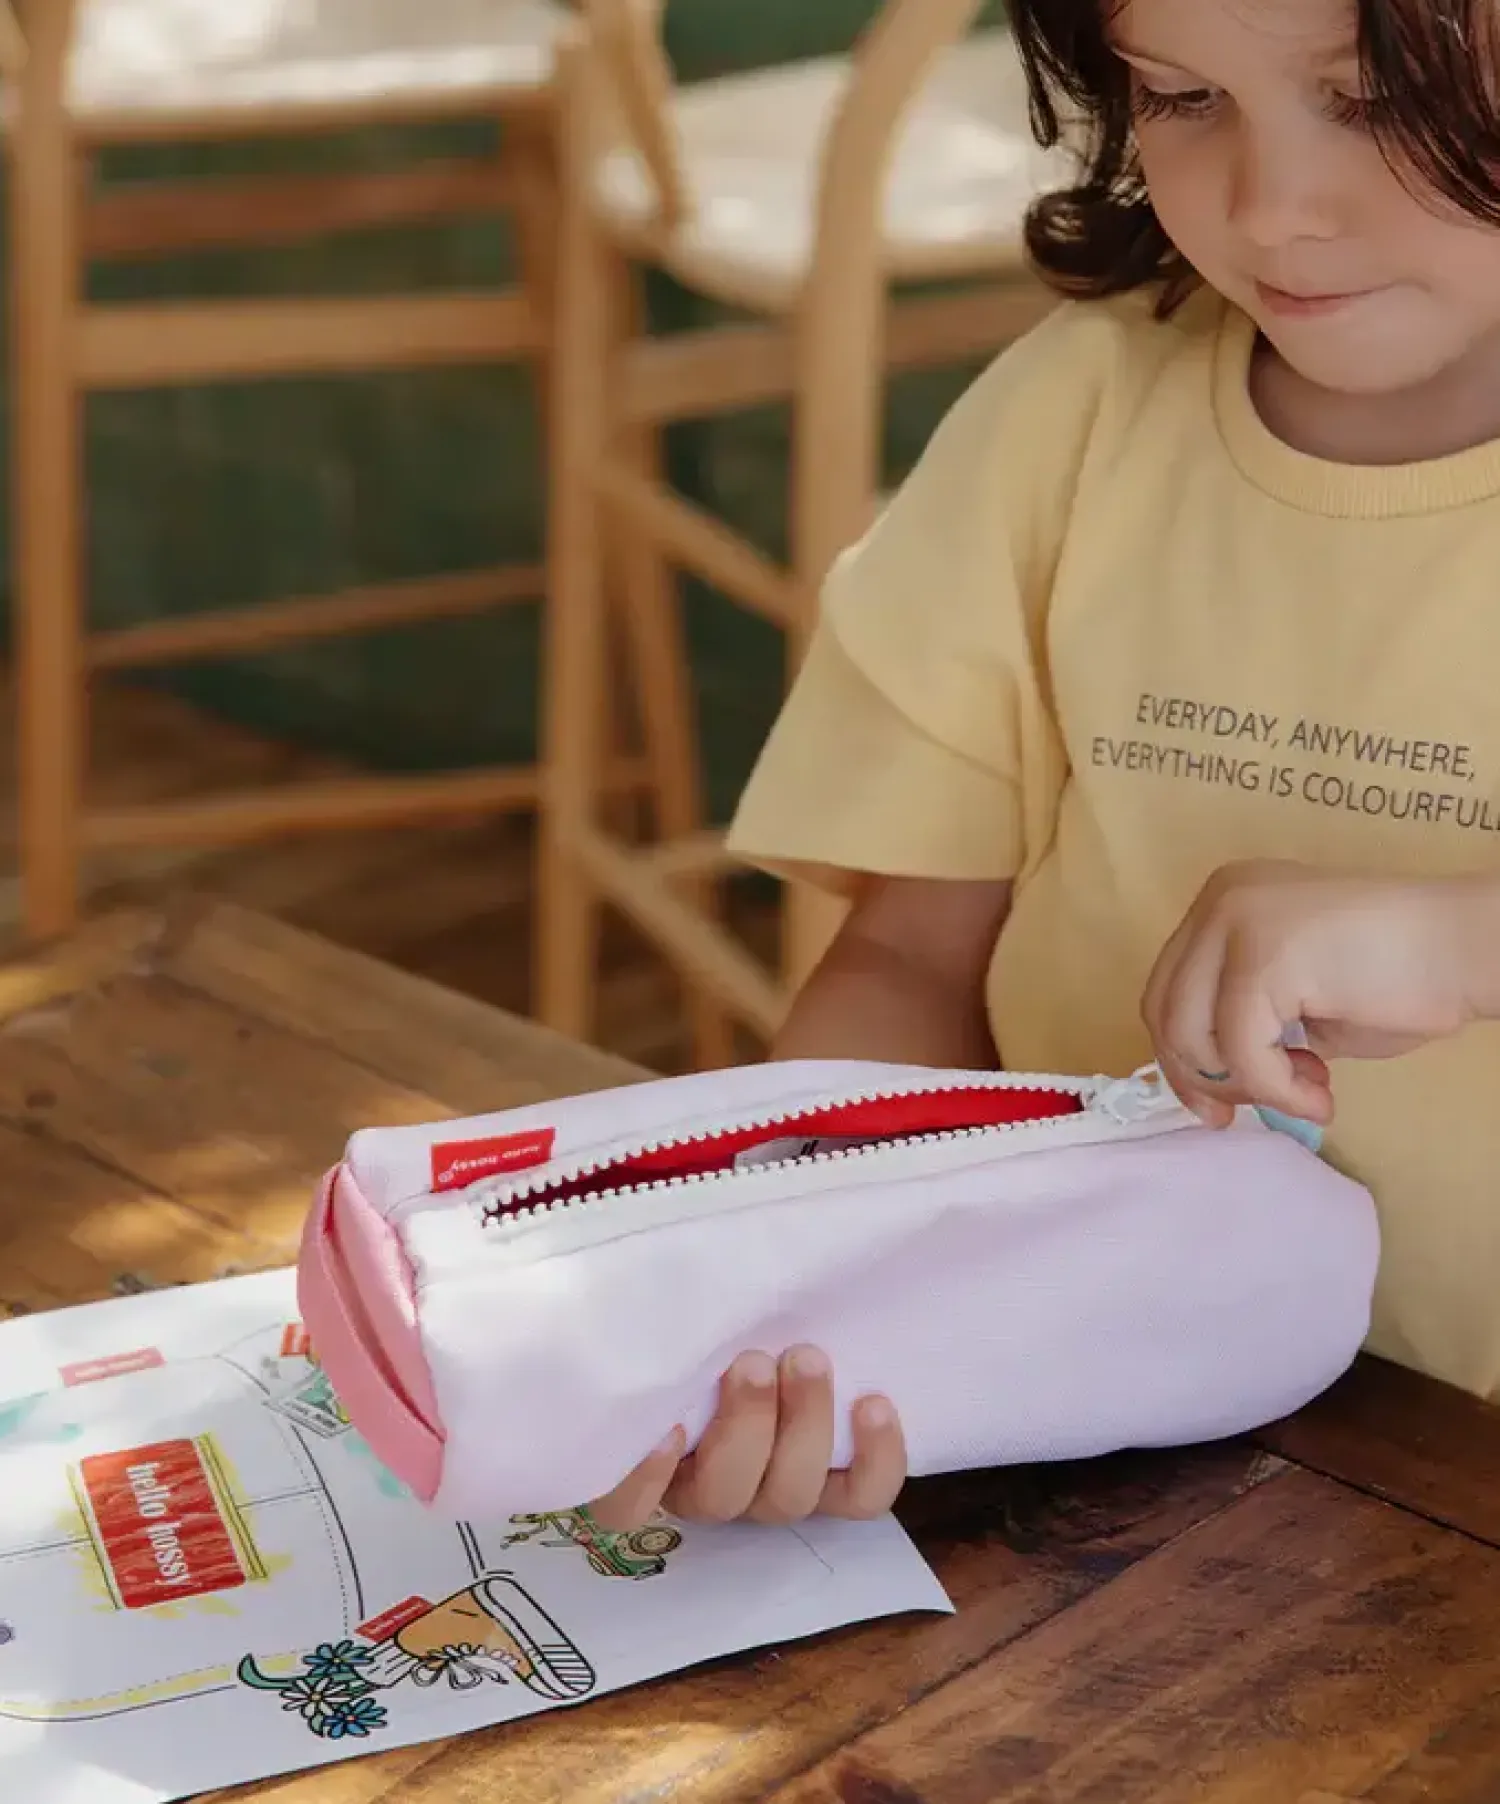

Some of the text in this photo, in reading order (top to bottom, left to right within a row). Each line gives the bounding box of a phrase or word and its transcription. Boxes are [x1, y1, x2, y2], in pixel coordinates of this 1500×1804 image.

[1136, 693, 1475, 782] EVERYDAY, ANYWHERE,
[1091, 736, 1500, 832] EVERYTHING IS COLOURFUL
[126, 1462, 171, 1518] hello
